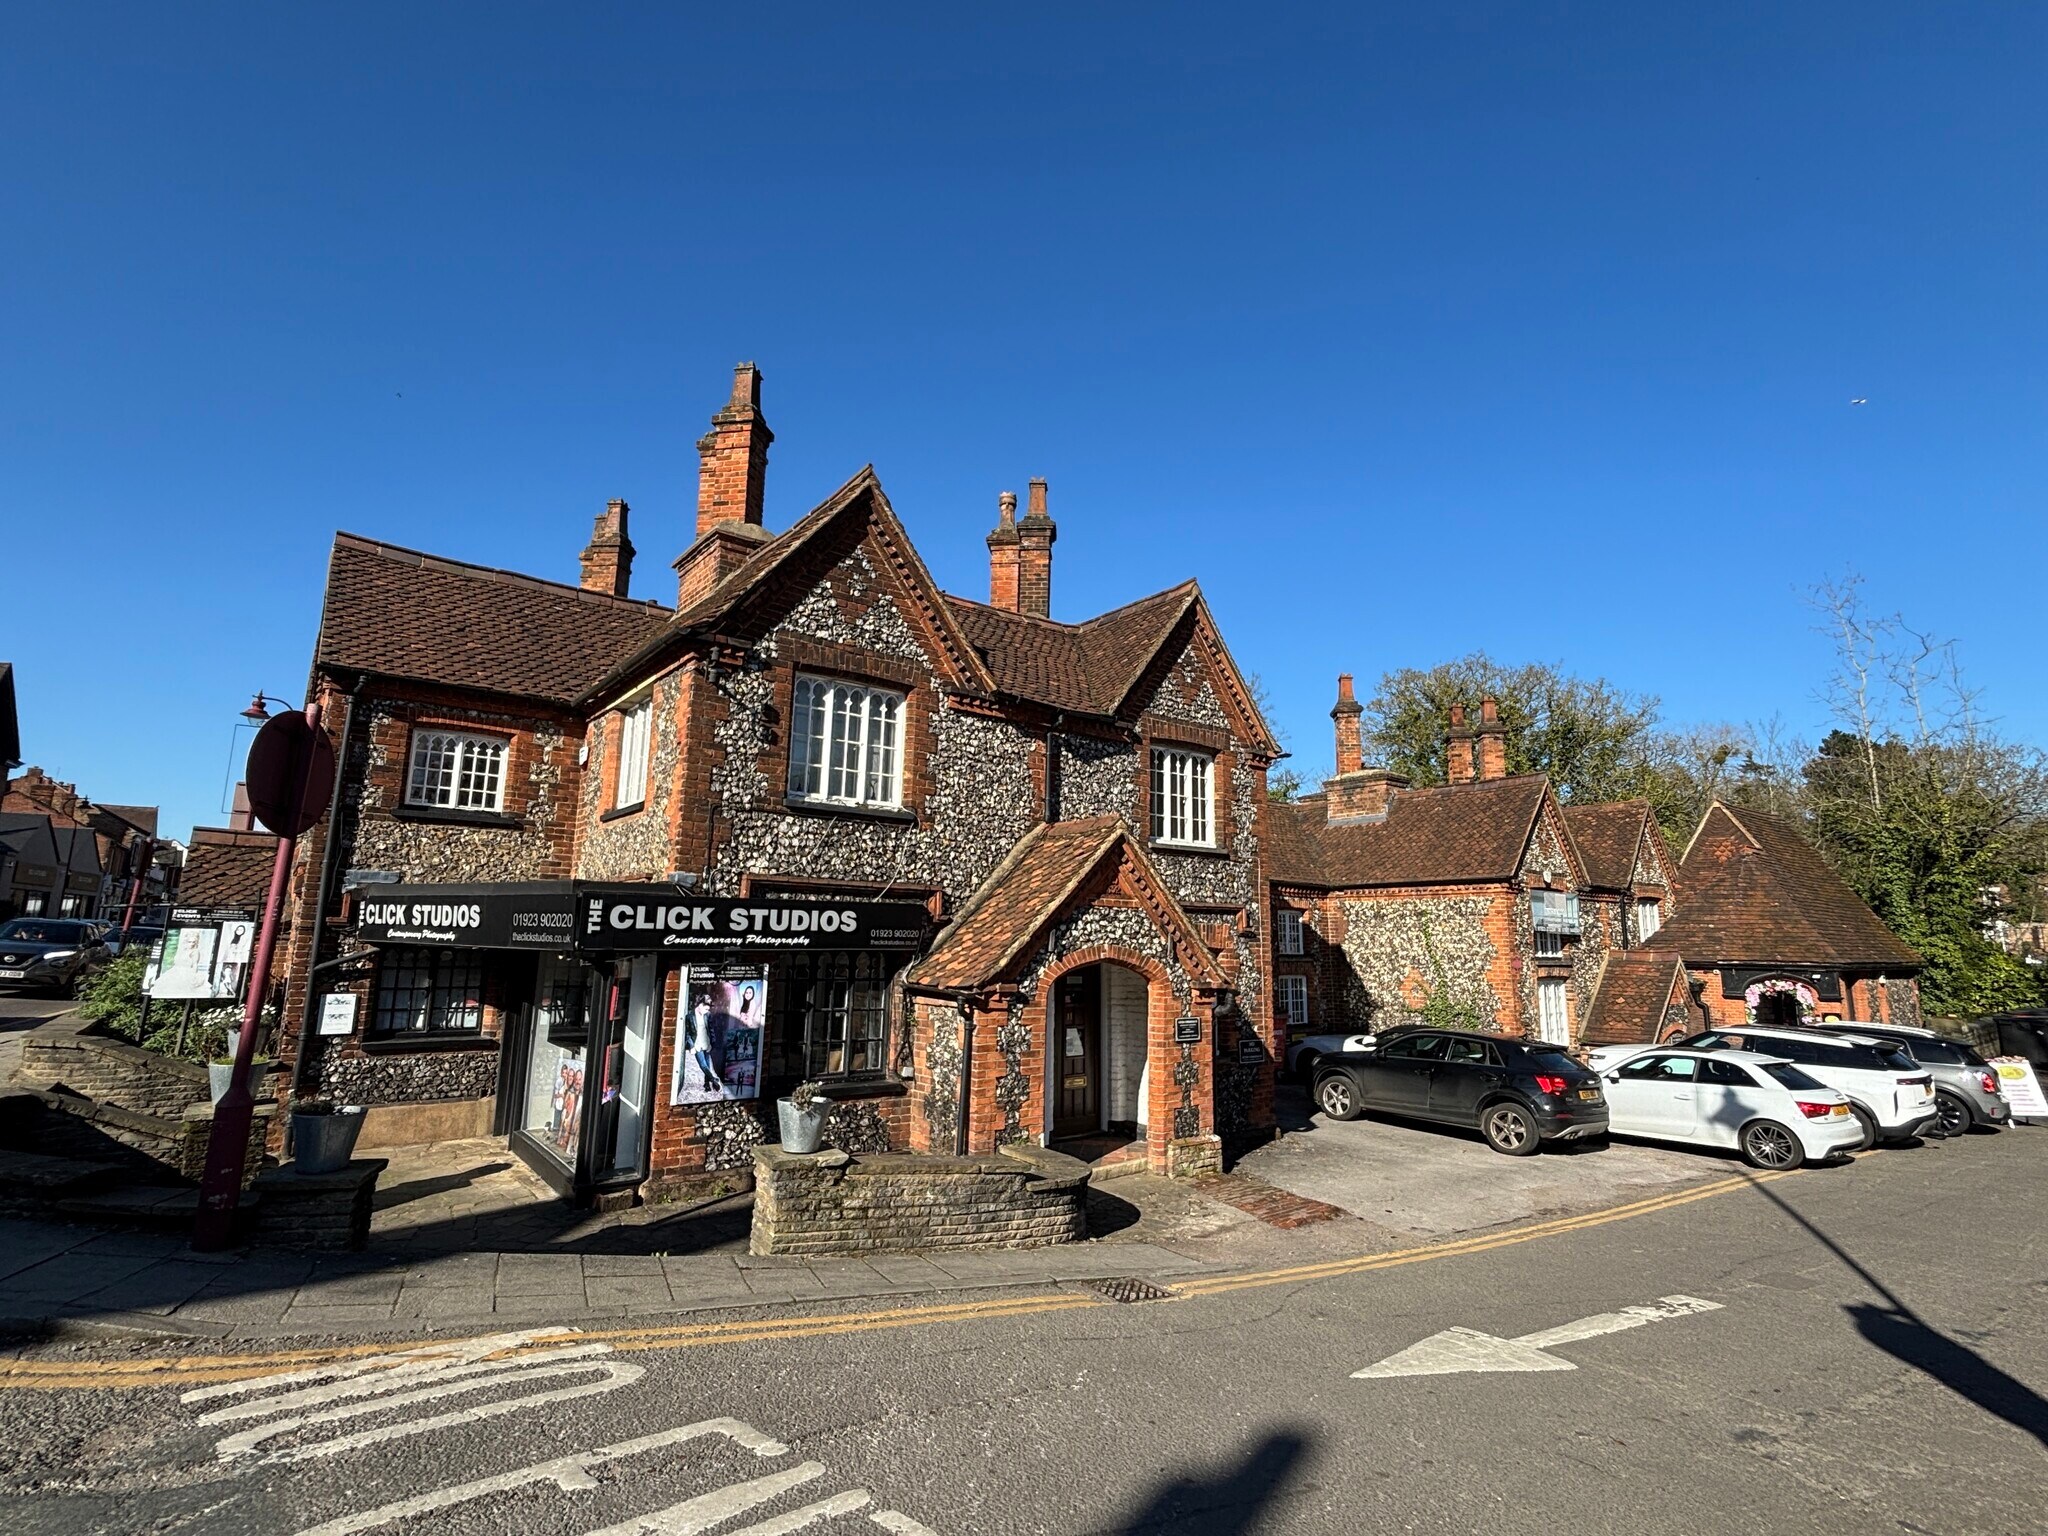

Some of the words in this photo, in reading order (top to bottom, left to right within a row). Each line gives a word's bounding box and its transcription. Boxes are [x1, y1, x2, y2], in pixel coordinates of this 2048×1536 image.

[358, 900, 366, 929] THE
[366, 904, 406, 926] CLICK
[412, 904, 481, 928] STUDIOS
[513, 913, 538, 927] 01923
[540, 913, 574, 928] 902020
[587, 898, 603, 935] THE
[609, 904, 715, 931] CLICK
[729, 908, 858, 933] STUDIOS
[387, 928, 421, 940] Contemporary
[422, 929, 455, 942] Photography
[512, 931, 571, 944] theclickstudios.co.uk
[663, 934, 743, 947] Contemporary
[746, 934, 810, 948] Photography
[870, 929, 893, 938] 01923
[894, 929, 919, 938] 902020
